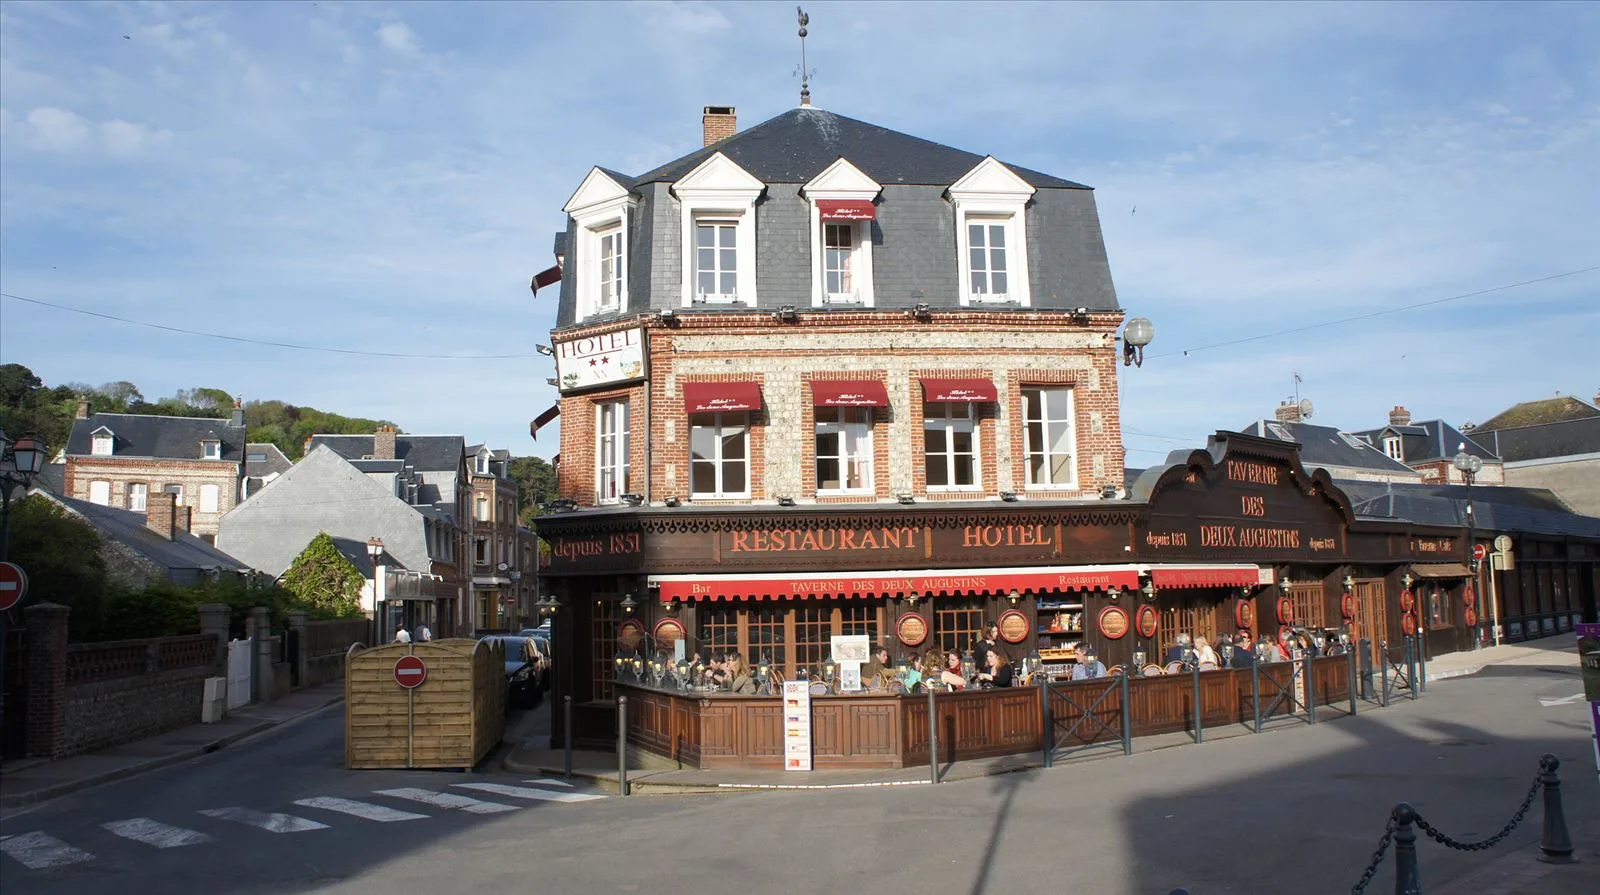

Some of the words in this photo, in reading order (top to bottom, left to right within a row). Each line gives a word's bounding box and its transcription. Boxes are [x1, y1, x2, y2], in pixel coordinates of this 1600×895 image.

[1227, 460, 1278, 485] TAVERNE
[1242, 496, 1265, 517] DES
[732, 527, 919, 551] RESTAURANT
[1146, 531, 1170, 549] depuis
[1171, 532, 1187, 547] 1851
[1200, 525, 1236, 547] DEUX
[1239, 527, 1300, 549] AUGUSTINS
[1309, 537, 1324, 551] depuis
[554, 537, 603, 562] depuis
[609, 532, 641, 556] 1851
[692, 584, 711, 594] Bar
[790, 581, 844, 593] TAVERNE
[852, 580, 875, 591] DES
[881, 579, 914, 591] DEUX
[922, 577, 986, 590] AUGUSTINS
[1058, 574, 1110, 586] Restaurant
